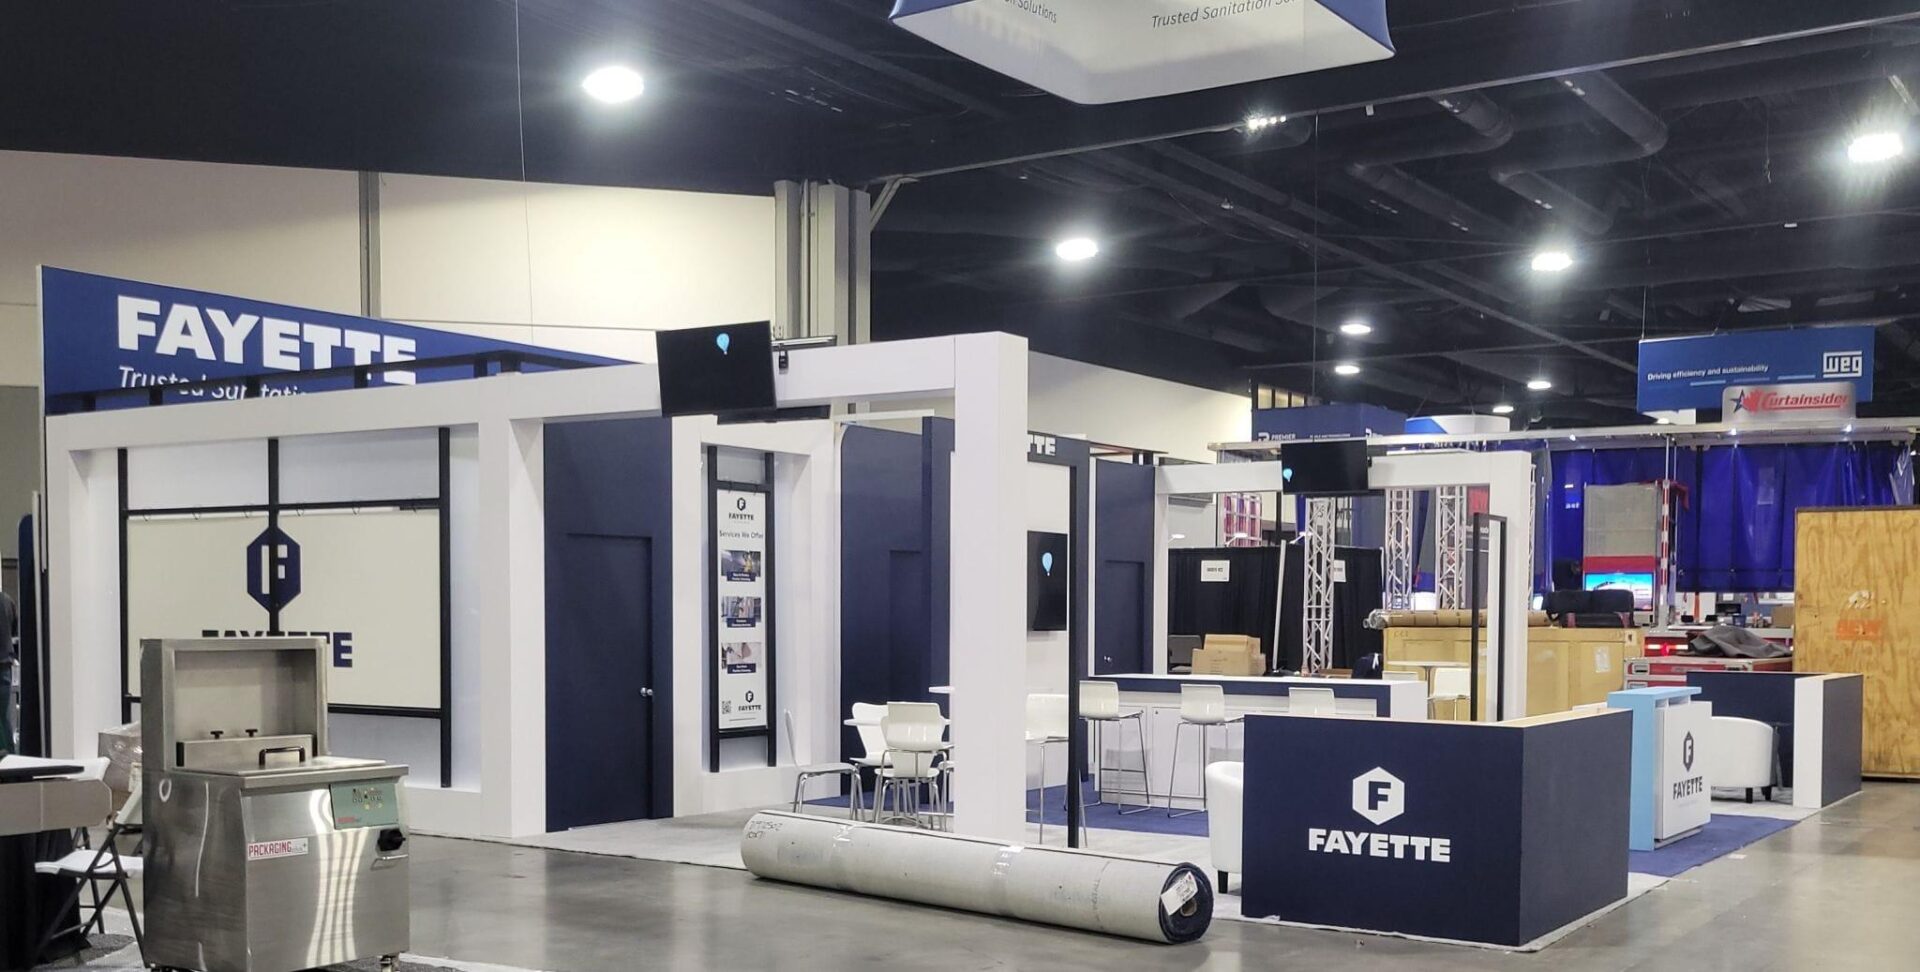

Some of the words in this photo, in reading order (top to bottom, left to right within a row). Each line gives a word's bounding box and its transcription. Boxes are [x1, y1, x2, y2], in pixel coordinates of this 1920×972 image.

[1152, 8, 1199, 28] Trusted
[1202, 0, 1271, 20] Sanitation
[117, 295, 416, 385] FAYETTE
[1647, 373, 1672, 381] Driving
[1673, 368, 1707, 379] efficiency
[1707, 367, 1721, 376] and
[1722, 364, 1769, 374] sustainability
[719, 529, 741, 539] Services
[1673, 775, 1703, 801] FAYETTE
[248, 840, 292, 857] PACKAGING
[1308, 827, 1451, 863] FAYETTE
